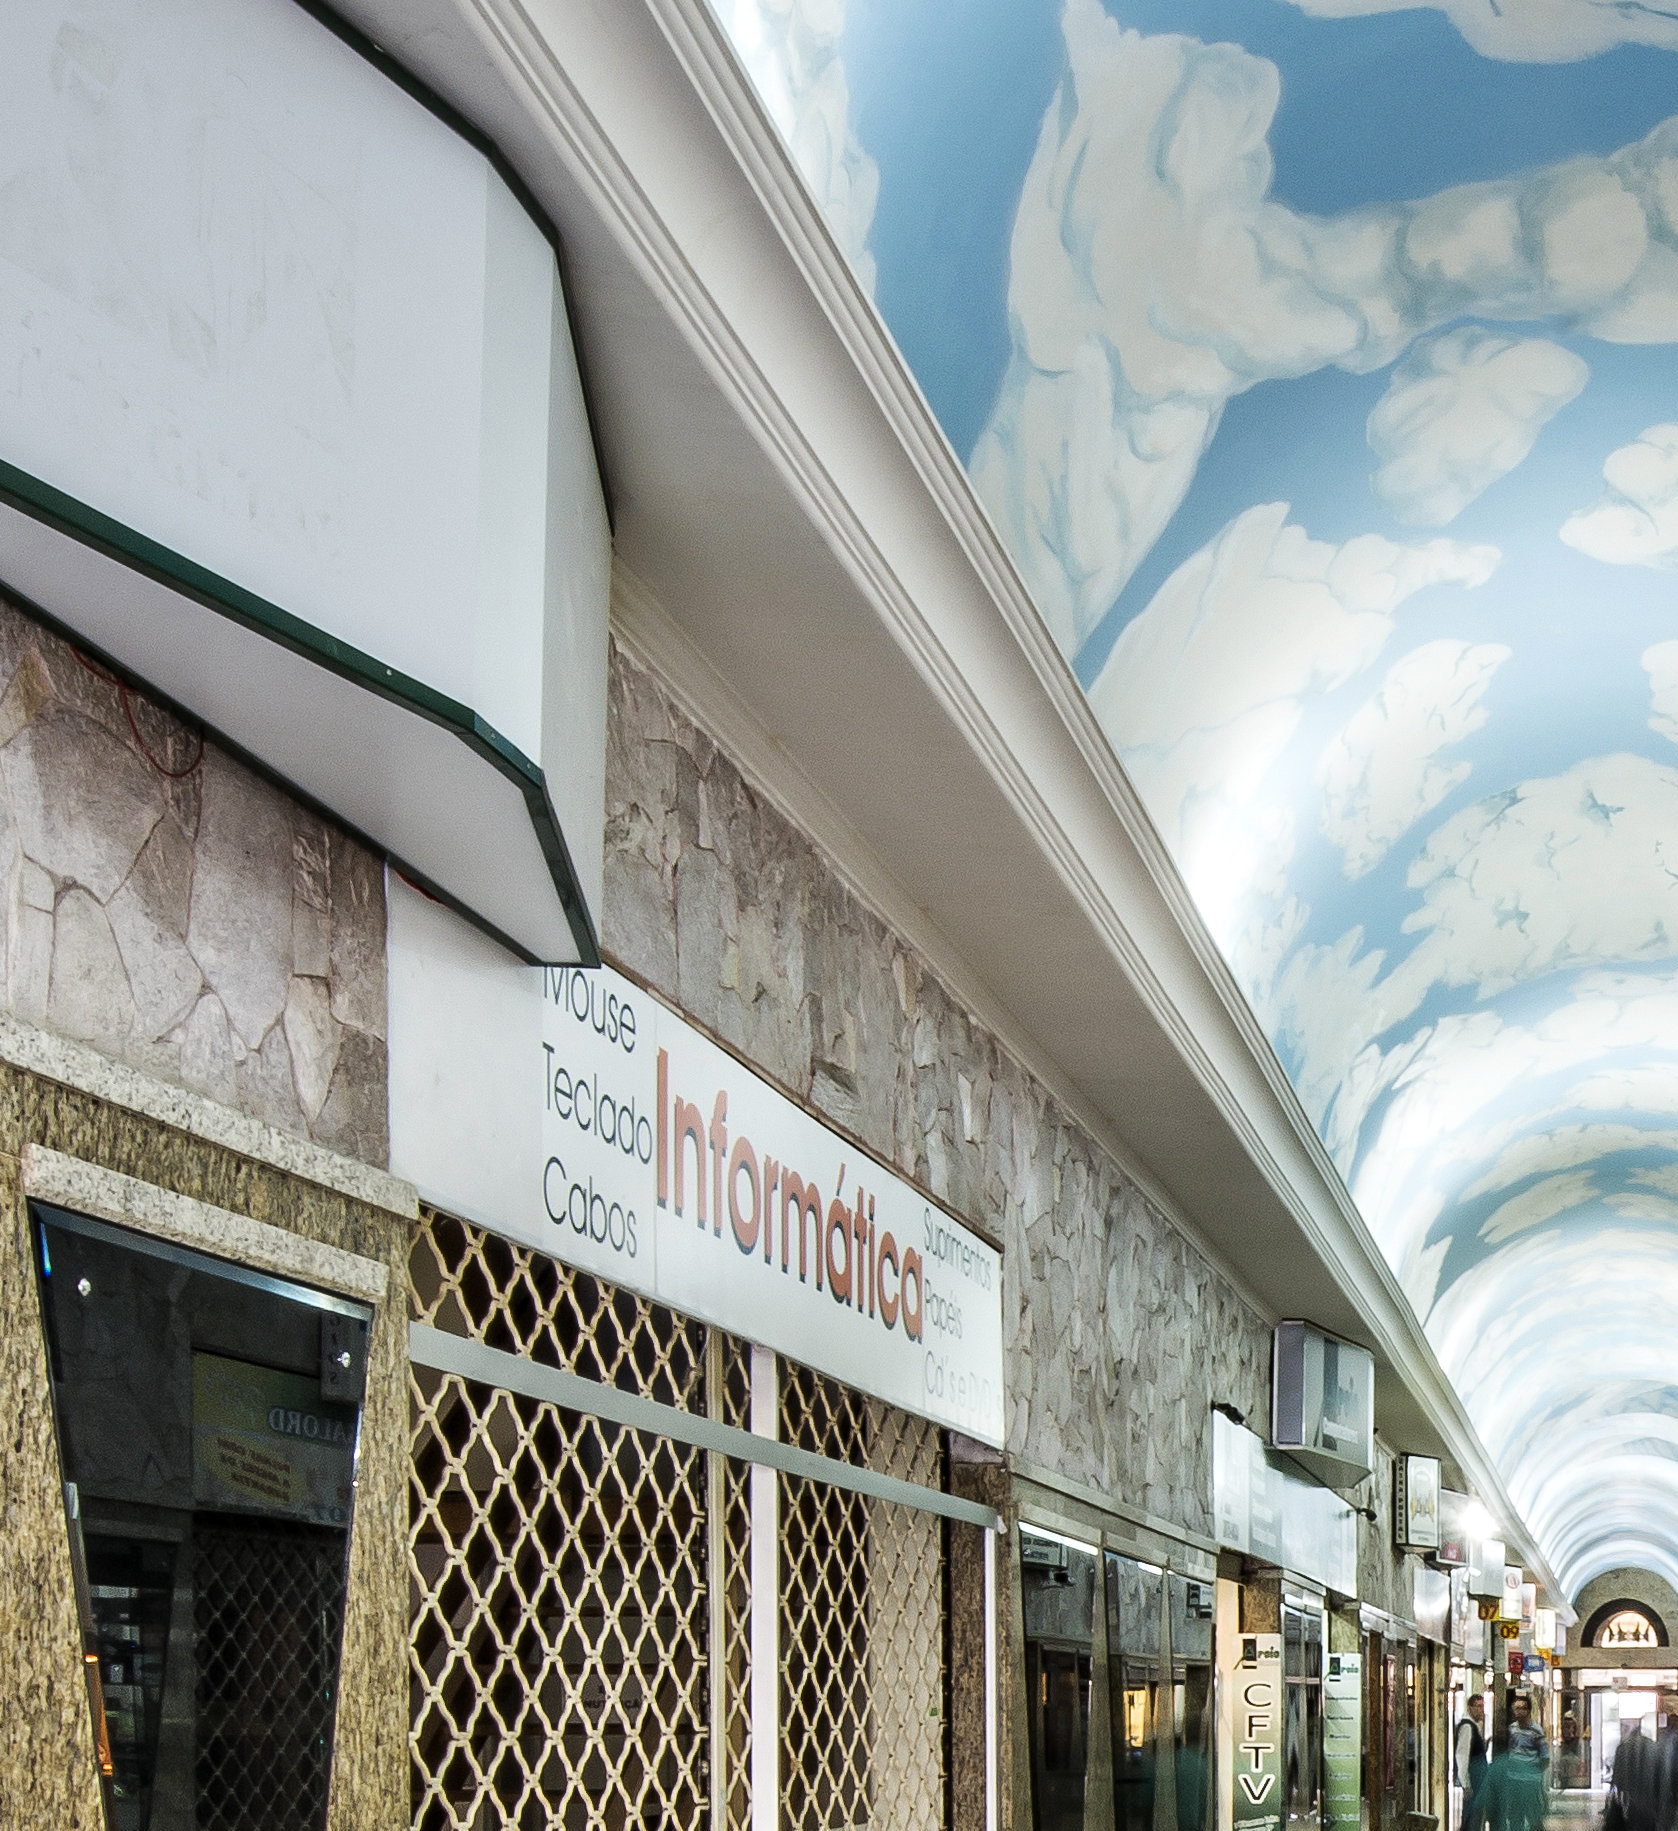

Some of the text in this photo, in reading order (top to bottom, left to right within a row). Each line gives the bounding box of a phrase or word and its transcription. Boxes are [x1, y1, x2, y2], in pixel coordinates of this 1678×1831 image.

[542, 1040, 653, 1165] Teclado
[542, 1156, 638, 1258] Cabos
[656, 1046, 924, 1345] Informática
[924, 1207, 992, 1292] Suprimentos
[1500, 1624, 1519, 1639] 09
[1241, 1682, 1273, 1803] CFTV
